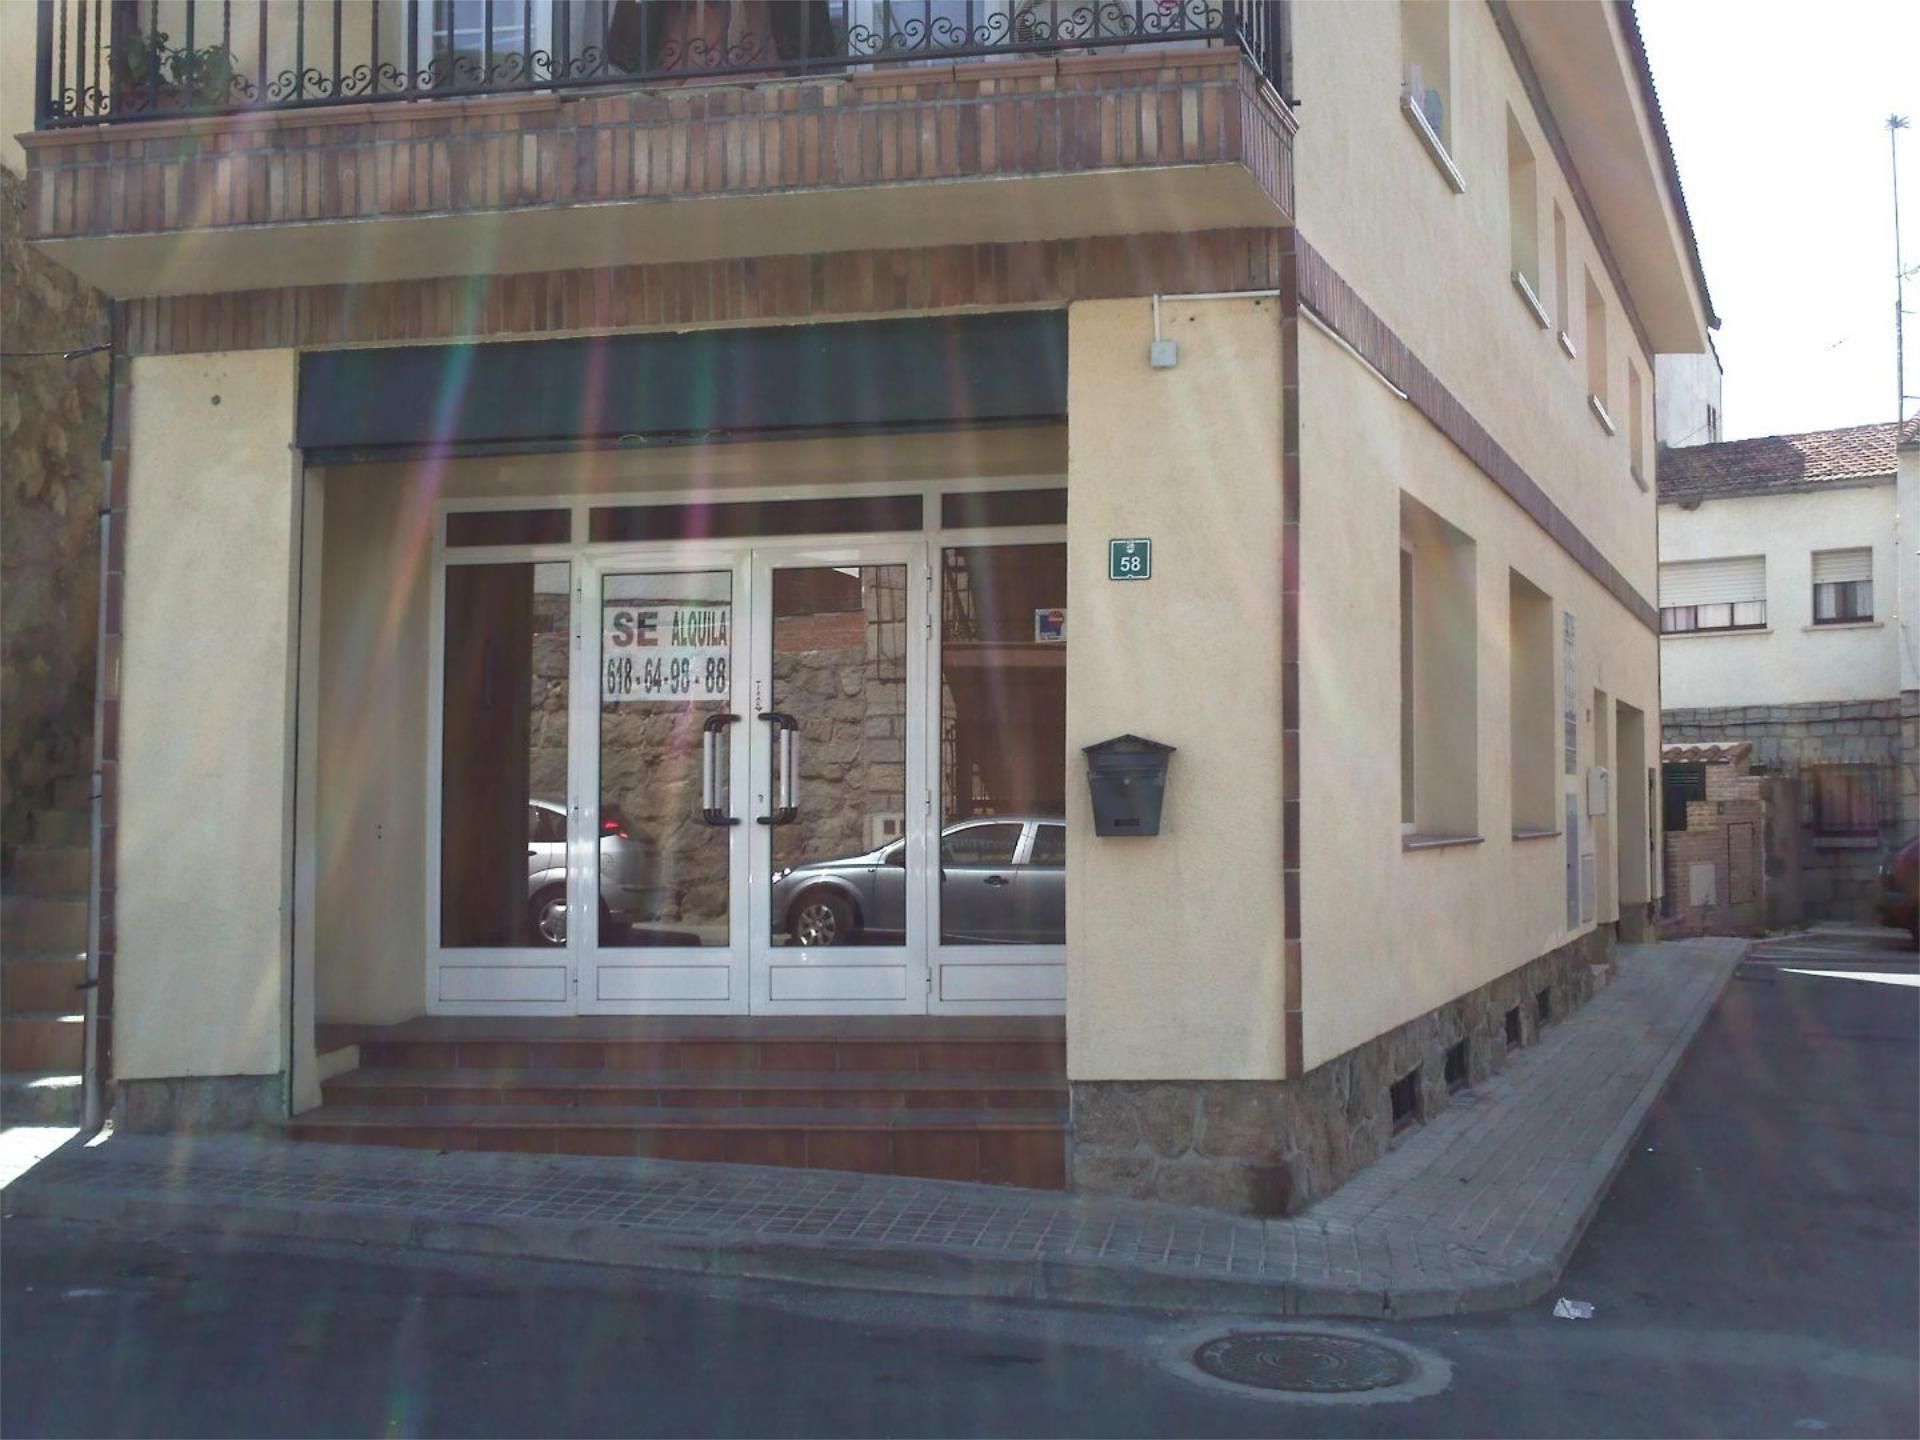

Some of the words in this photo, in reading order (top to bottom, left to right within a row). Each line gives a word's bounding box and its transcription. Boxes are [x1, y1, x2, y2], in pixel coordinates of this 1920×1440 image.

[1120, 556, 1141, 571] 58
[611, 611, 658, 647] SE
[671, 611, 728, 648] ALQUILA
